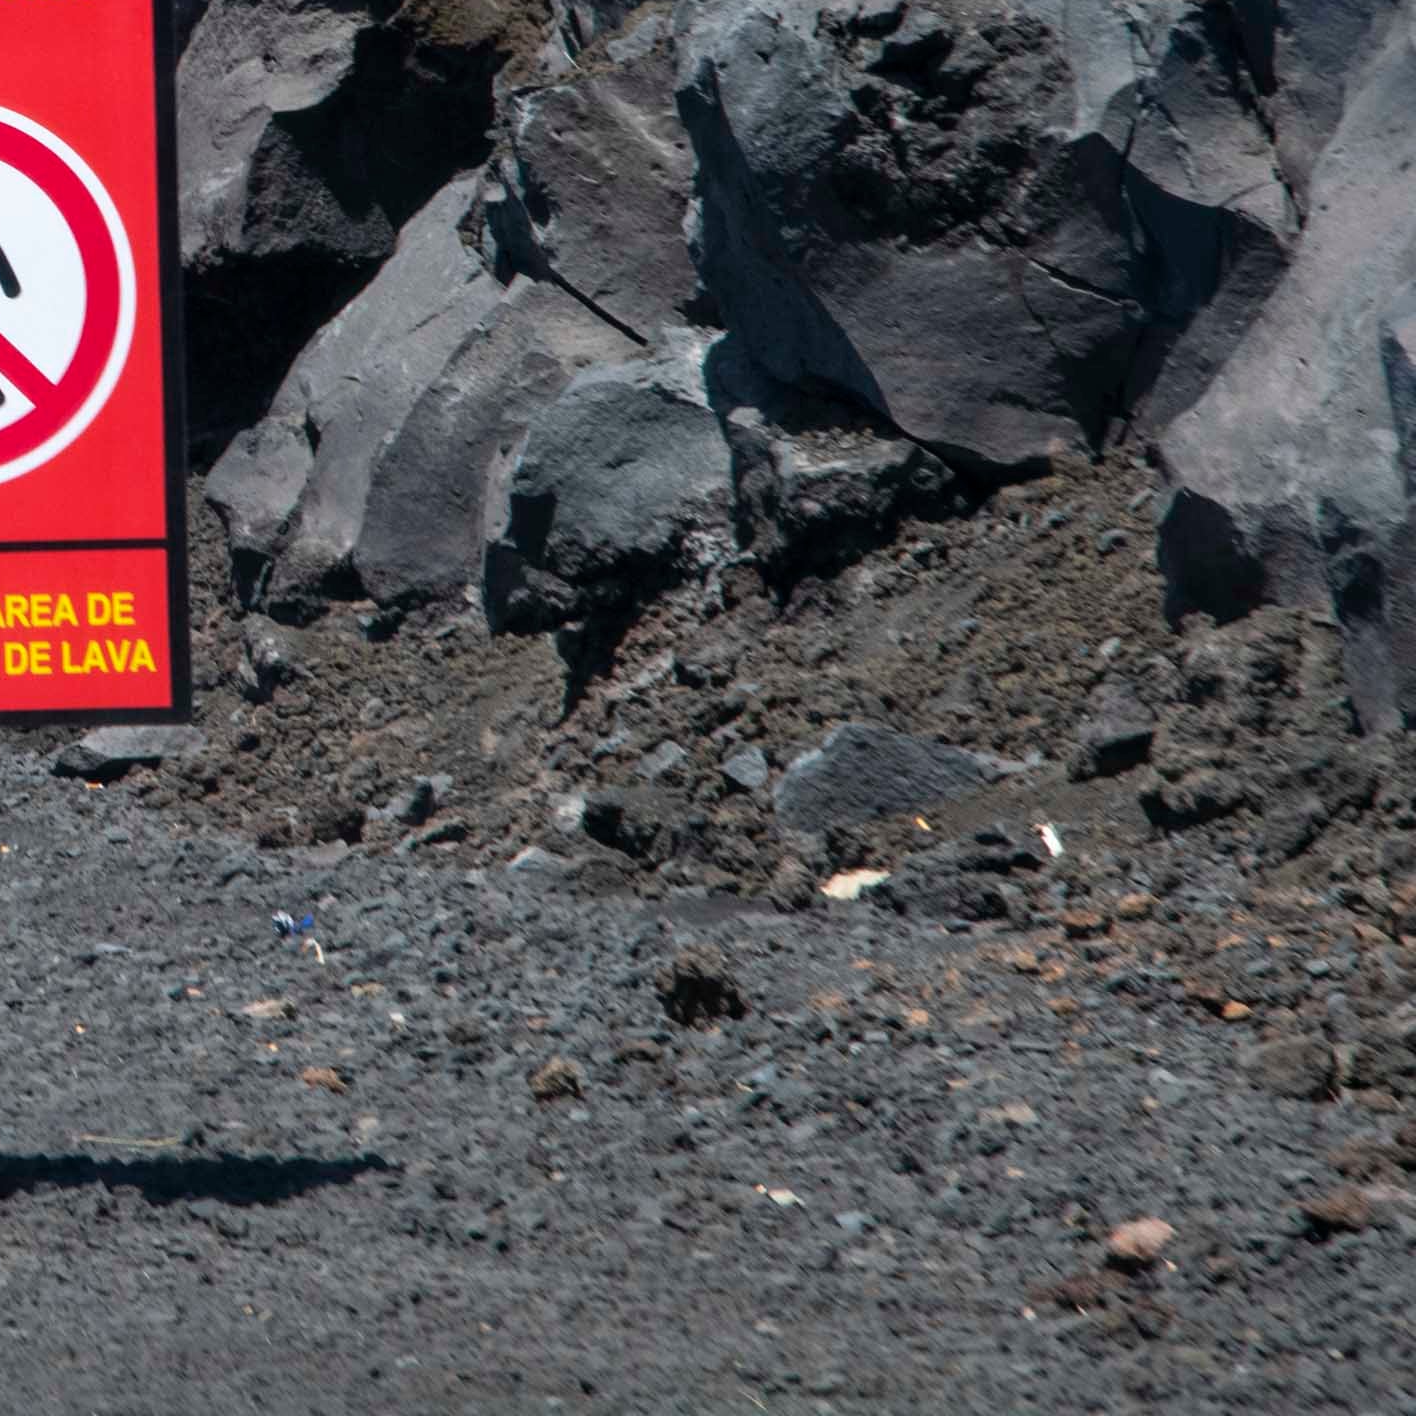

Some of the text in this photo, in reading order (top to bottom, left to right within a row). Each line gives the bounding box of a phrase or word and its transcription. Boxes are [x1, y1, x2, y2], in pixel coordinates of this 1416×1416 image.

[87, 592, 135, 626] DE
[4, 641, 52, 675] DE
[61, 639, 156, 674] LAVA
